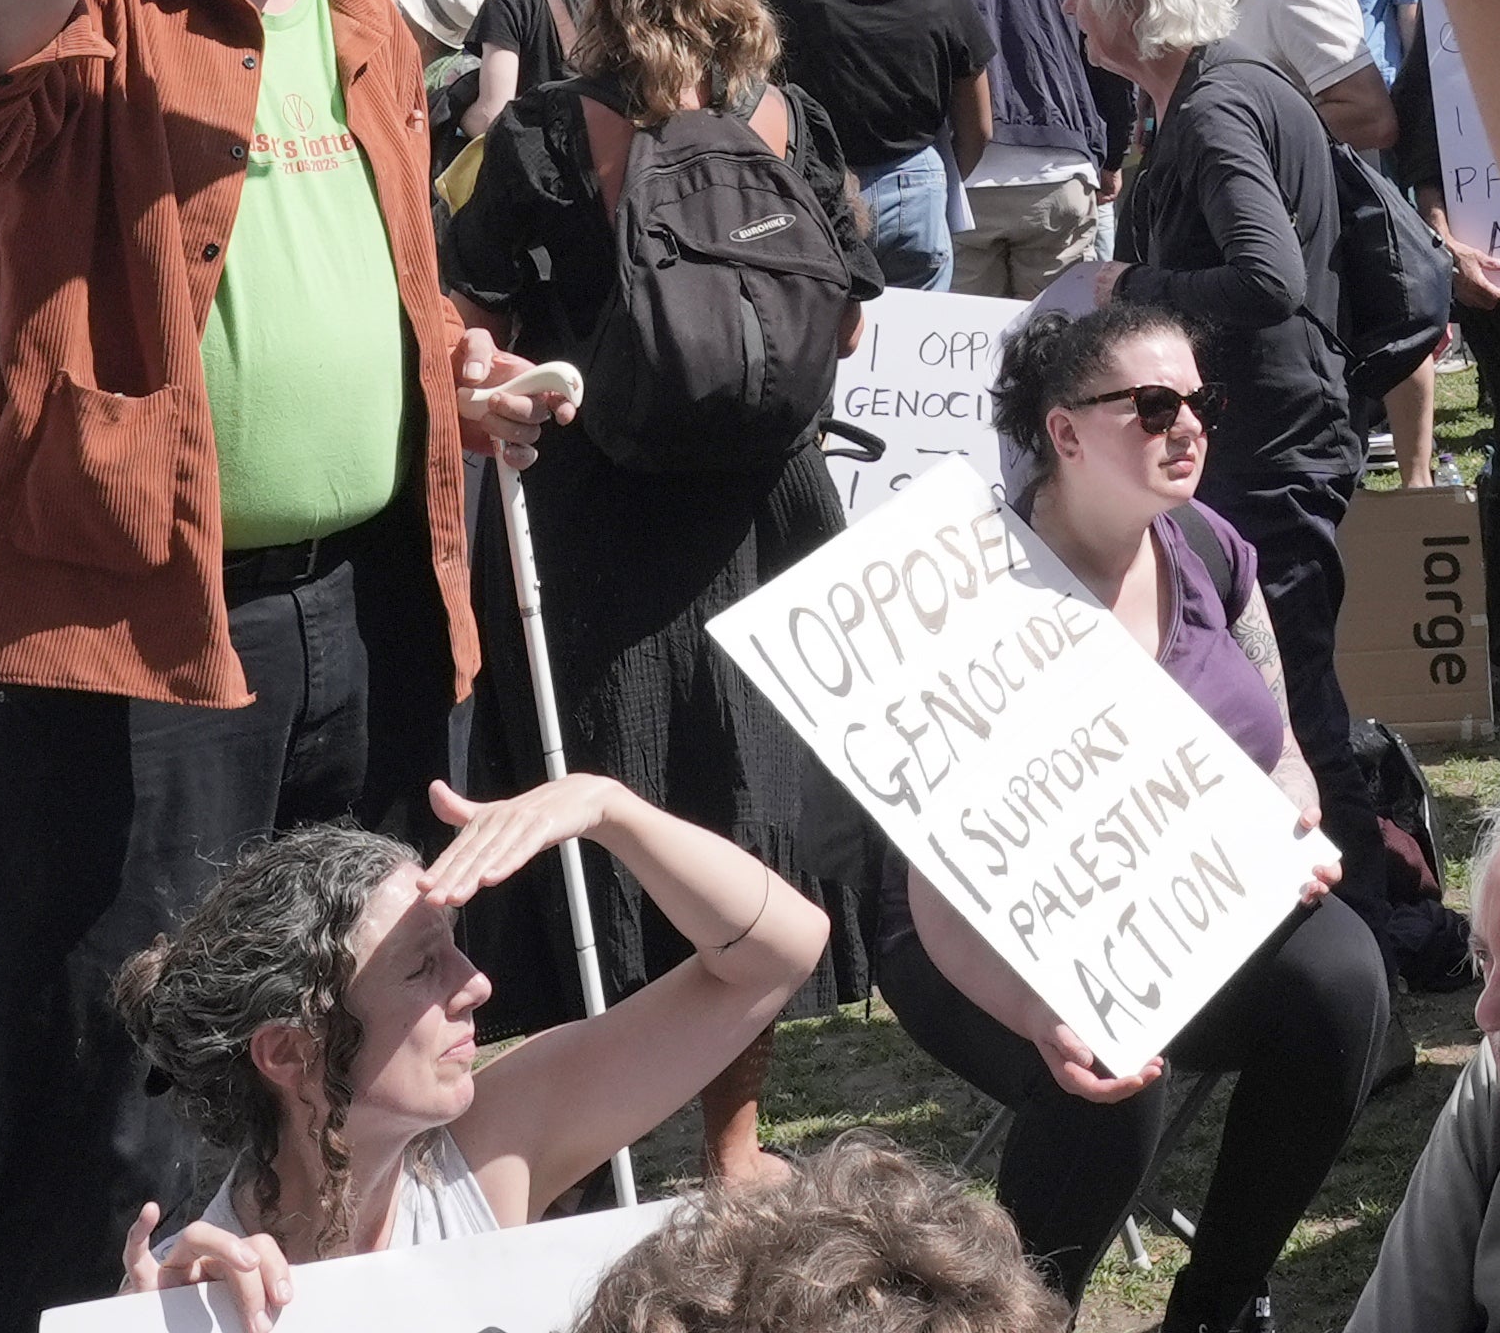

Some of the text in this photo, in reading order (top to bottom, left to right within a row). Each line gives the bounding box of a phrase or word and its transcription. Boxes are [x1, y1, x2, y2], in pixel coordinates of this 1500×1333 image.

[739, 217, 787, 239] EUROHIKE
[871, 323, 878, 372] I
[750, 507, 1031, 726] I OPPOSE
[843, 593, 1100, 819] GENOCIDE
[1414, 534, 1470, 686] large
[928, 703, 1131, 914] I SUPPORT
[1009, 736, 1225, 962] PALESTINE
[1073, 833, 1247, 1044] ACTION
